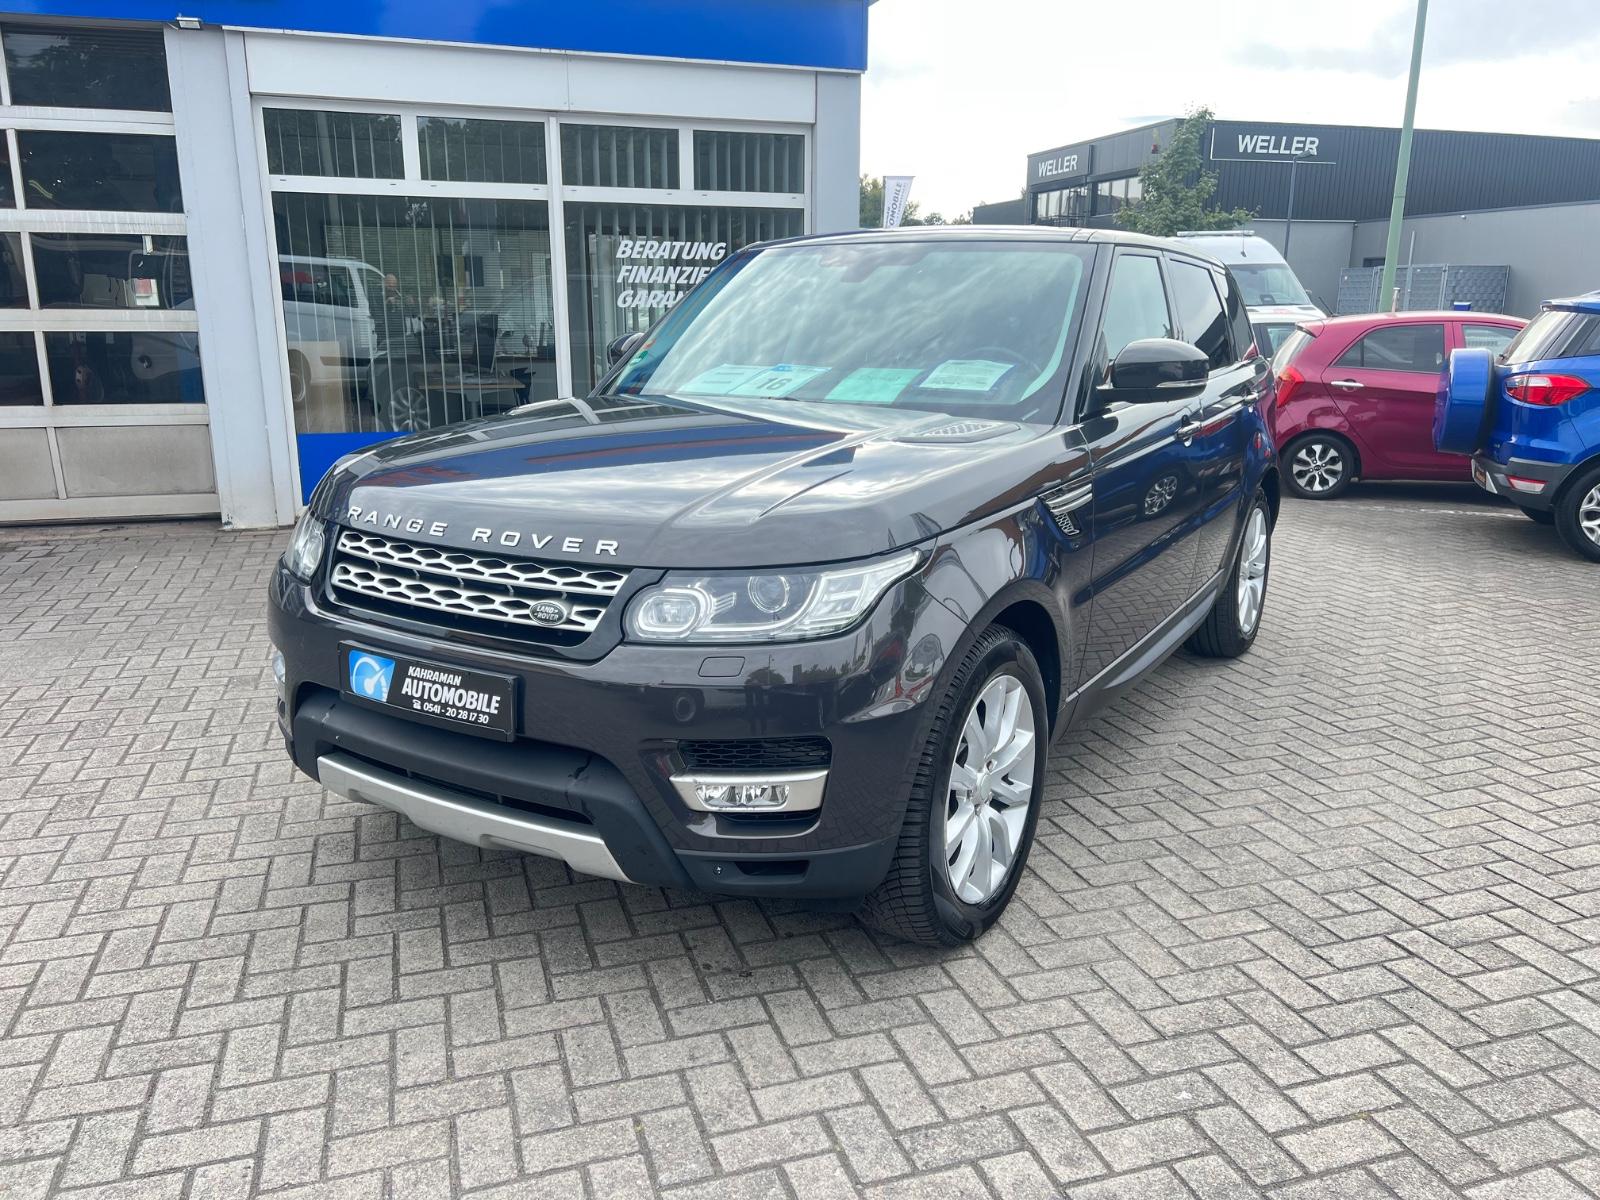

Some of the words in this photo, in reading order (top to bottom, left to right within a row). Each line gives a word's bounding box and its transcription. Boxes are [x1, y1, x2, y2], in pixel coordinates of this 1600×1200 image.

[1238, 134, 1319, 155] WELLER
[1038, 154, 1078, 177] WELLER
[616, 240, 727, 260] BERATUNG
[617, 265, 716, 284] FINANZIE
[347, 506, 448, 537] RANGE
[471, 527, 619, 556] ROVER
[407, 665, 462, 687] KAHRAMAN
[401, 678, 501, 715] AUTOMOBILE
[423, 702, 441, 714] 0541
[446, 707, 457, 717] 20
[457, 709, 468, 720] 28
[469, 712, 478, 722] 17
[477, 714, 489, 724] 30
